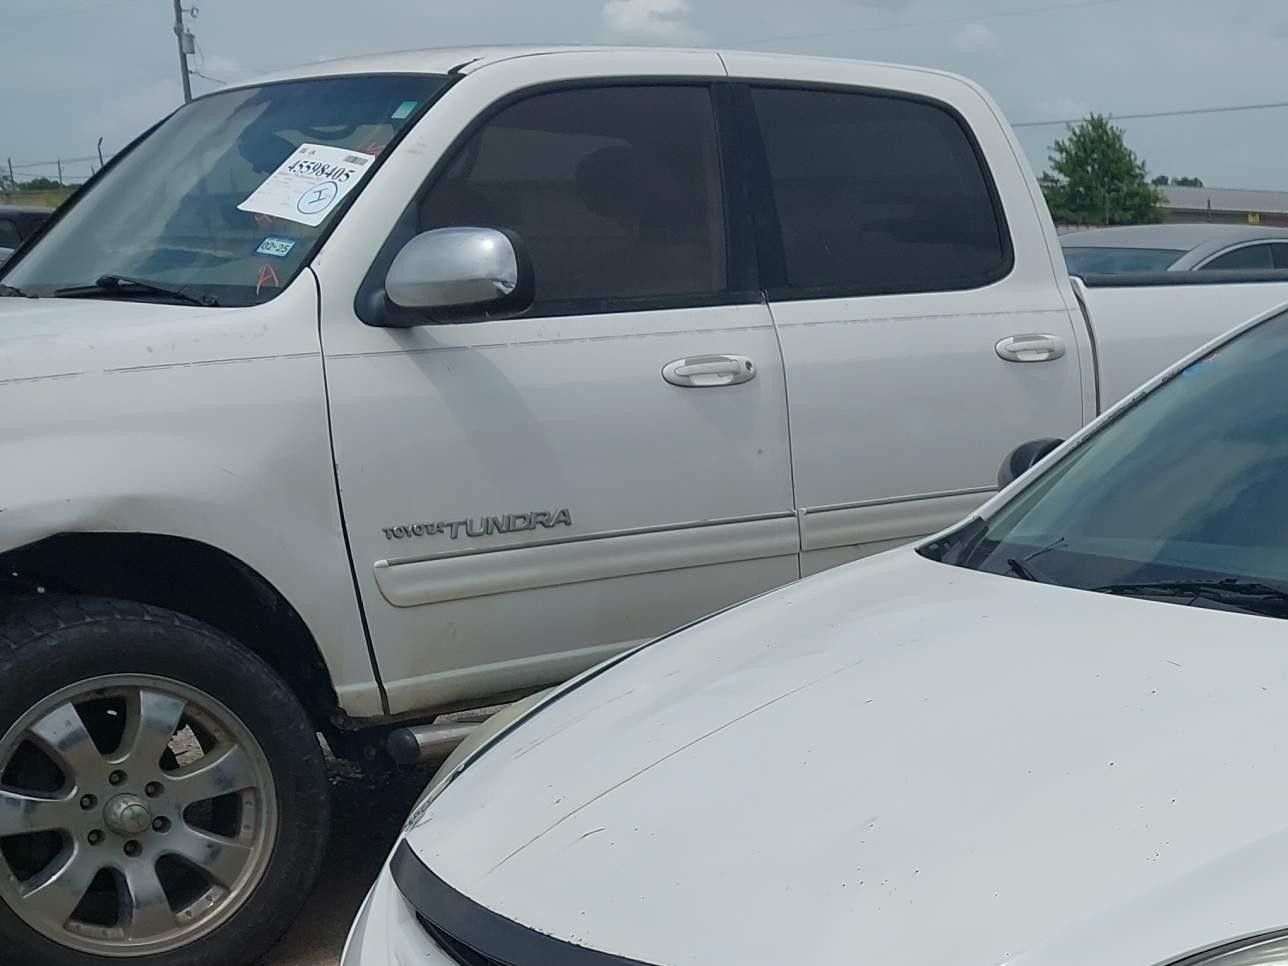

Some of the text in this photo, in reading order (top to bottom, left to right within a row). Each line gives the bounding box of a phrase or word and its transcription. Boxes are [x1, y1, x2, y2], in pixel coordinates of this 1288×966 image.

[288, 160, 356, 182] 45598405
[382, 508, 572, 541] TOYOTA TUNDRA
